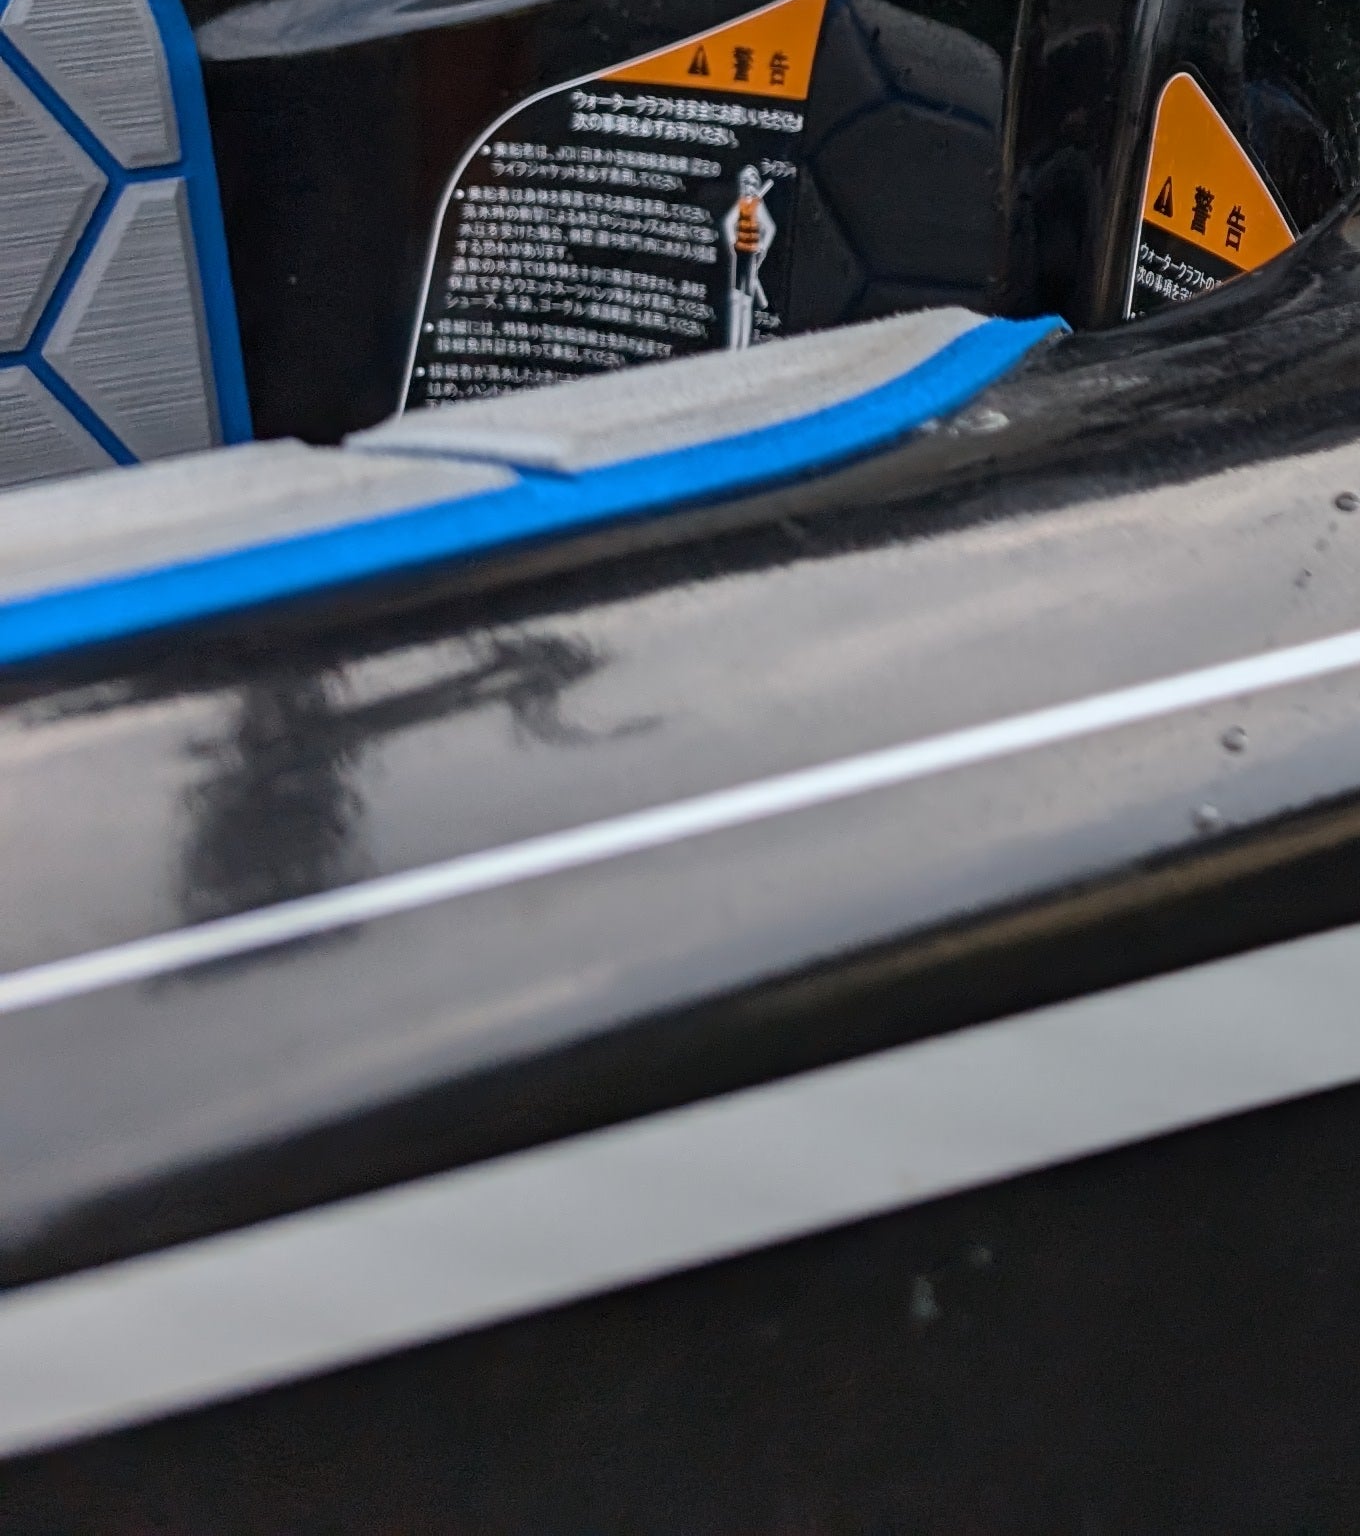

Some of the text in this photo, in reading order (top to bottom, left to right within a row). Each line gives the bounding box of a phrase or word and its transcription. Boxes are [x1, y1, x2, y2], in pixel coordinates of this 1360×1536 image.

[1189, 184, 1247, 253] 警告
[1140, 242, 1223, 291] ウォータークラフトの
